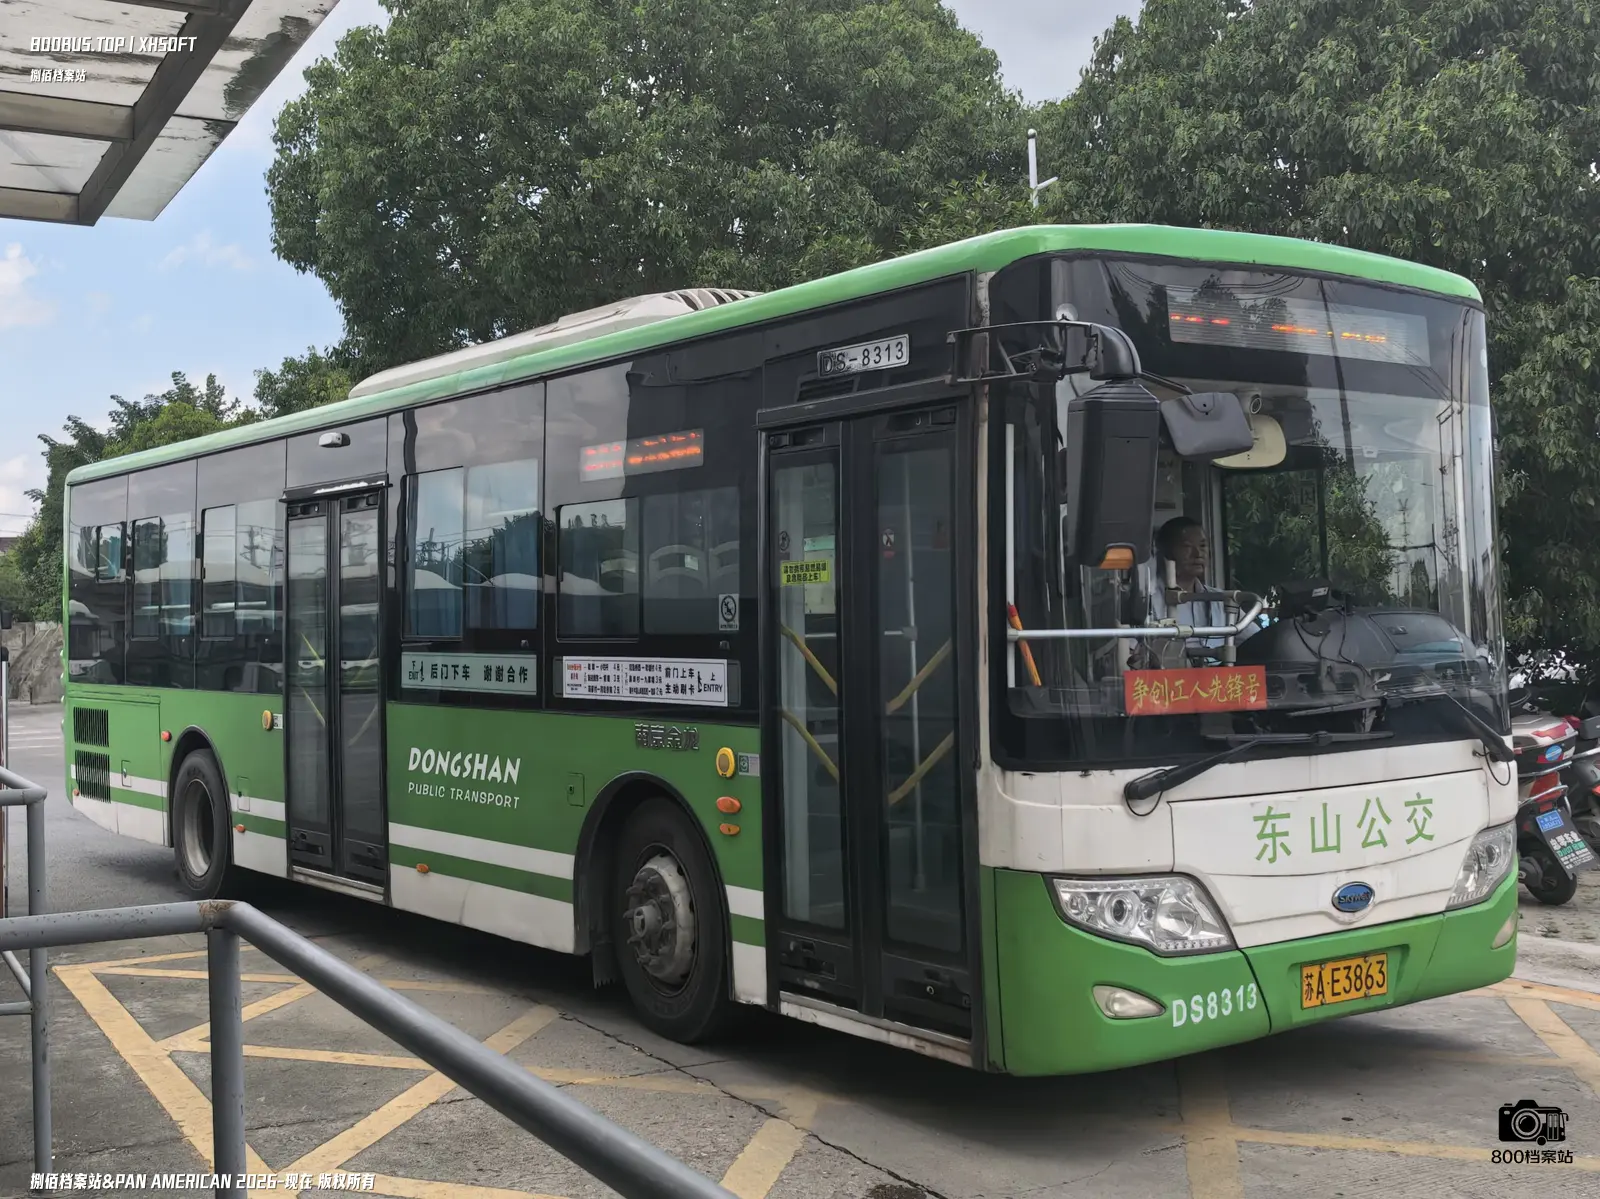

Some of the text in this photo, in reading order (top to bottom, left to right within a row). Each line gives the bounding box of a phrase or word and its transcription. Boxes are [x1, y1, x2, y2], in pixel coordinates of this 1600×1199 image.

[822, 341, 904, 374] DS-8313
[430, 663, 528, 683] 后门下车 谢谢合作
[665, 666, 695, 679] 前门上车
[710, 672, 716, 681] 上
[665, 683, 695, 695] 主动刷卡
[703, 683, 723, 693] ENTRY
[1132, 673, 1262, 709] 争创工人先锋号
[408, 747, 522, 785] DONGSHAN
[408, 782, 520, 809] PUBLIC TRANSPORT
[1253, 792, 1435, 864] 东山公交
[1172, 983, 1258, 1028] DS8313
